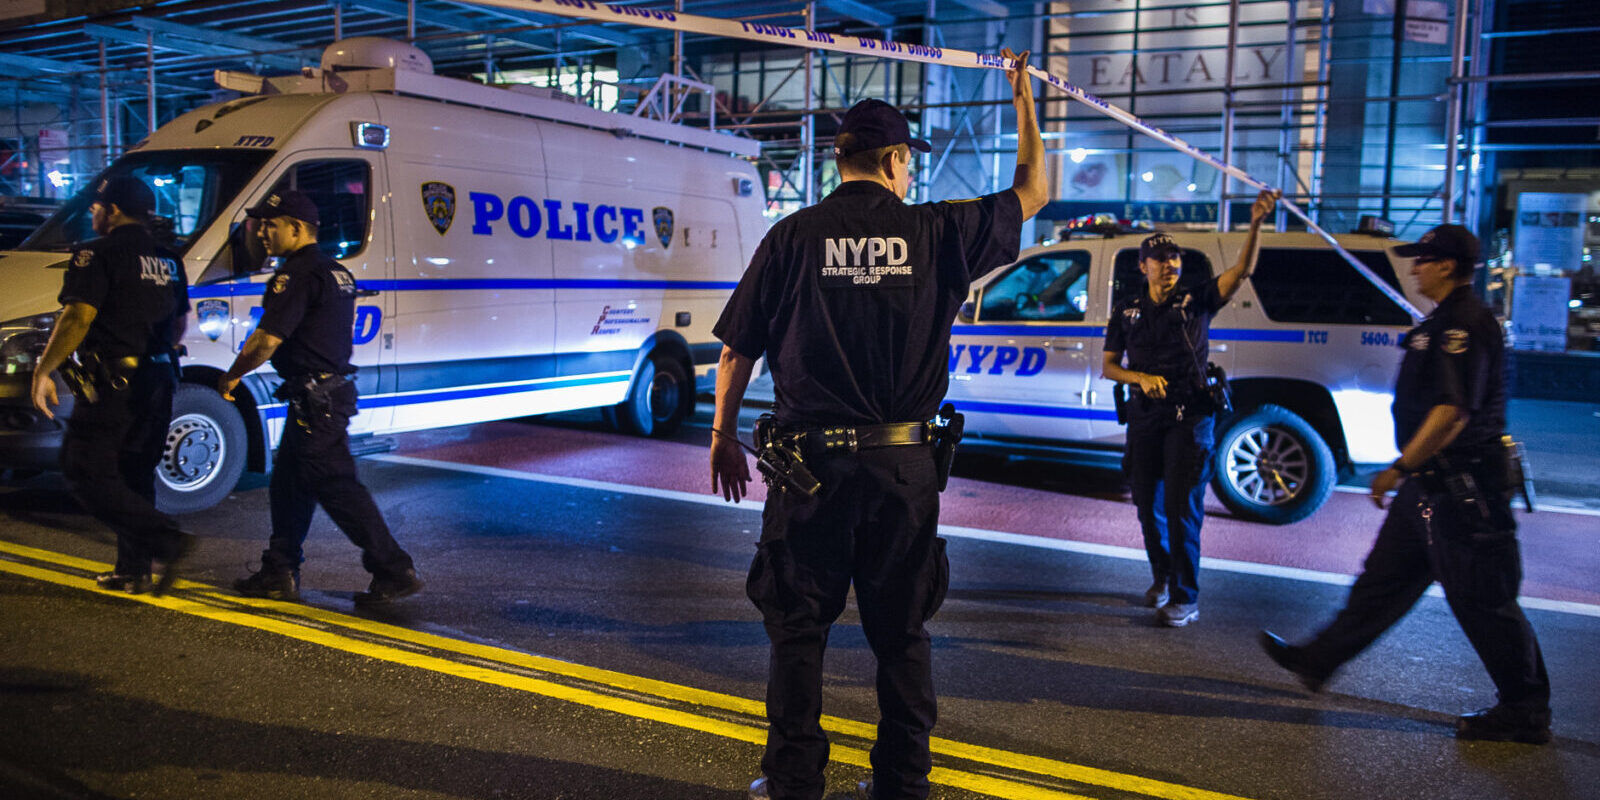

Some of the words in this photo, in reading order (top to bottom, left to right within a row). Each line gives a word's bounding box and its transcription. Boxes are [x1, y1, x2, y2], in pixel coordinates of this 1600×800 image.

[739, 21, 796, 39] POLICE
[234, 135, 275, 148] NYPD
[469, 191, 647, 246] POLICE
[1124, 203, 1218, 220] EATALY
[825, 236, 908, 267] NYPD
[139, 255, 178, 277] NYPD
[822, 266, 867, 277] STRATEGIC
[869, 265, 913, 276] RESPONSE
[853, 275, 882, 285] GROUP
[1307, 330, 1328, 344] TCU
[1360, 331, 1389, 346] 5600
[949, 343, 1048, 376] NYPD
